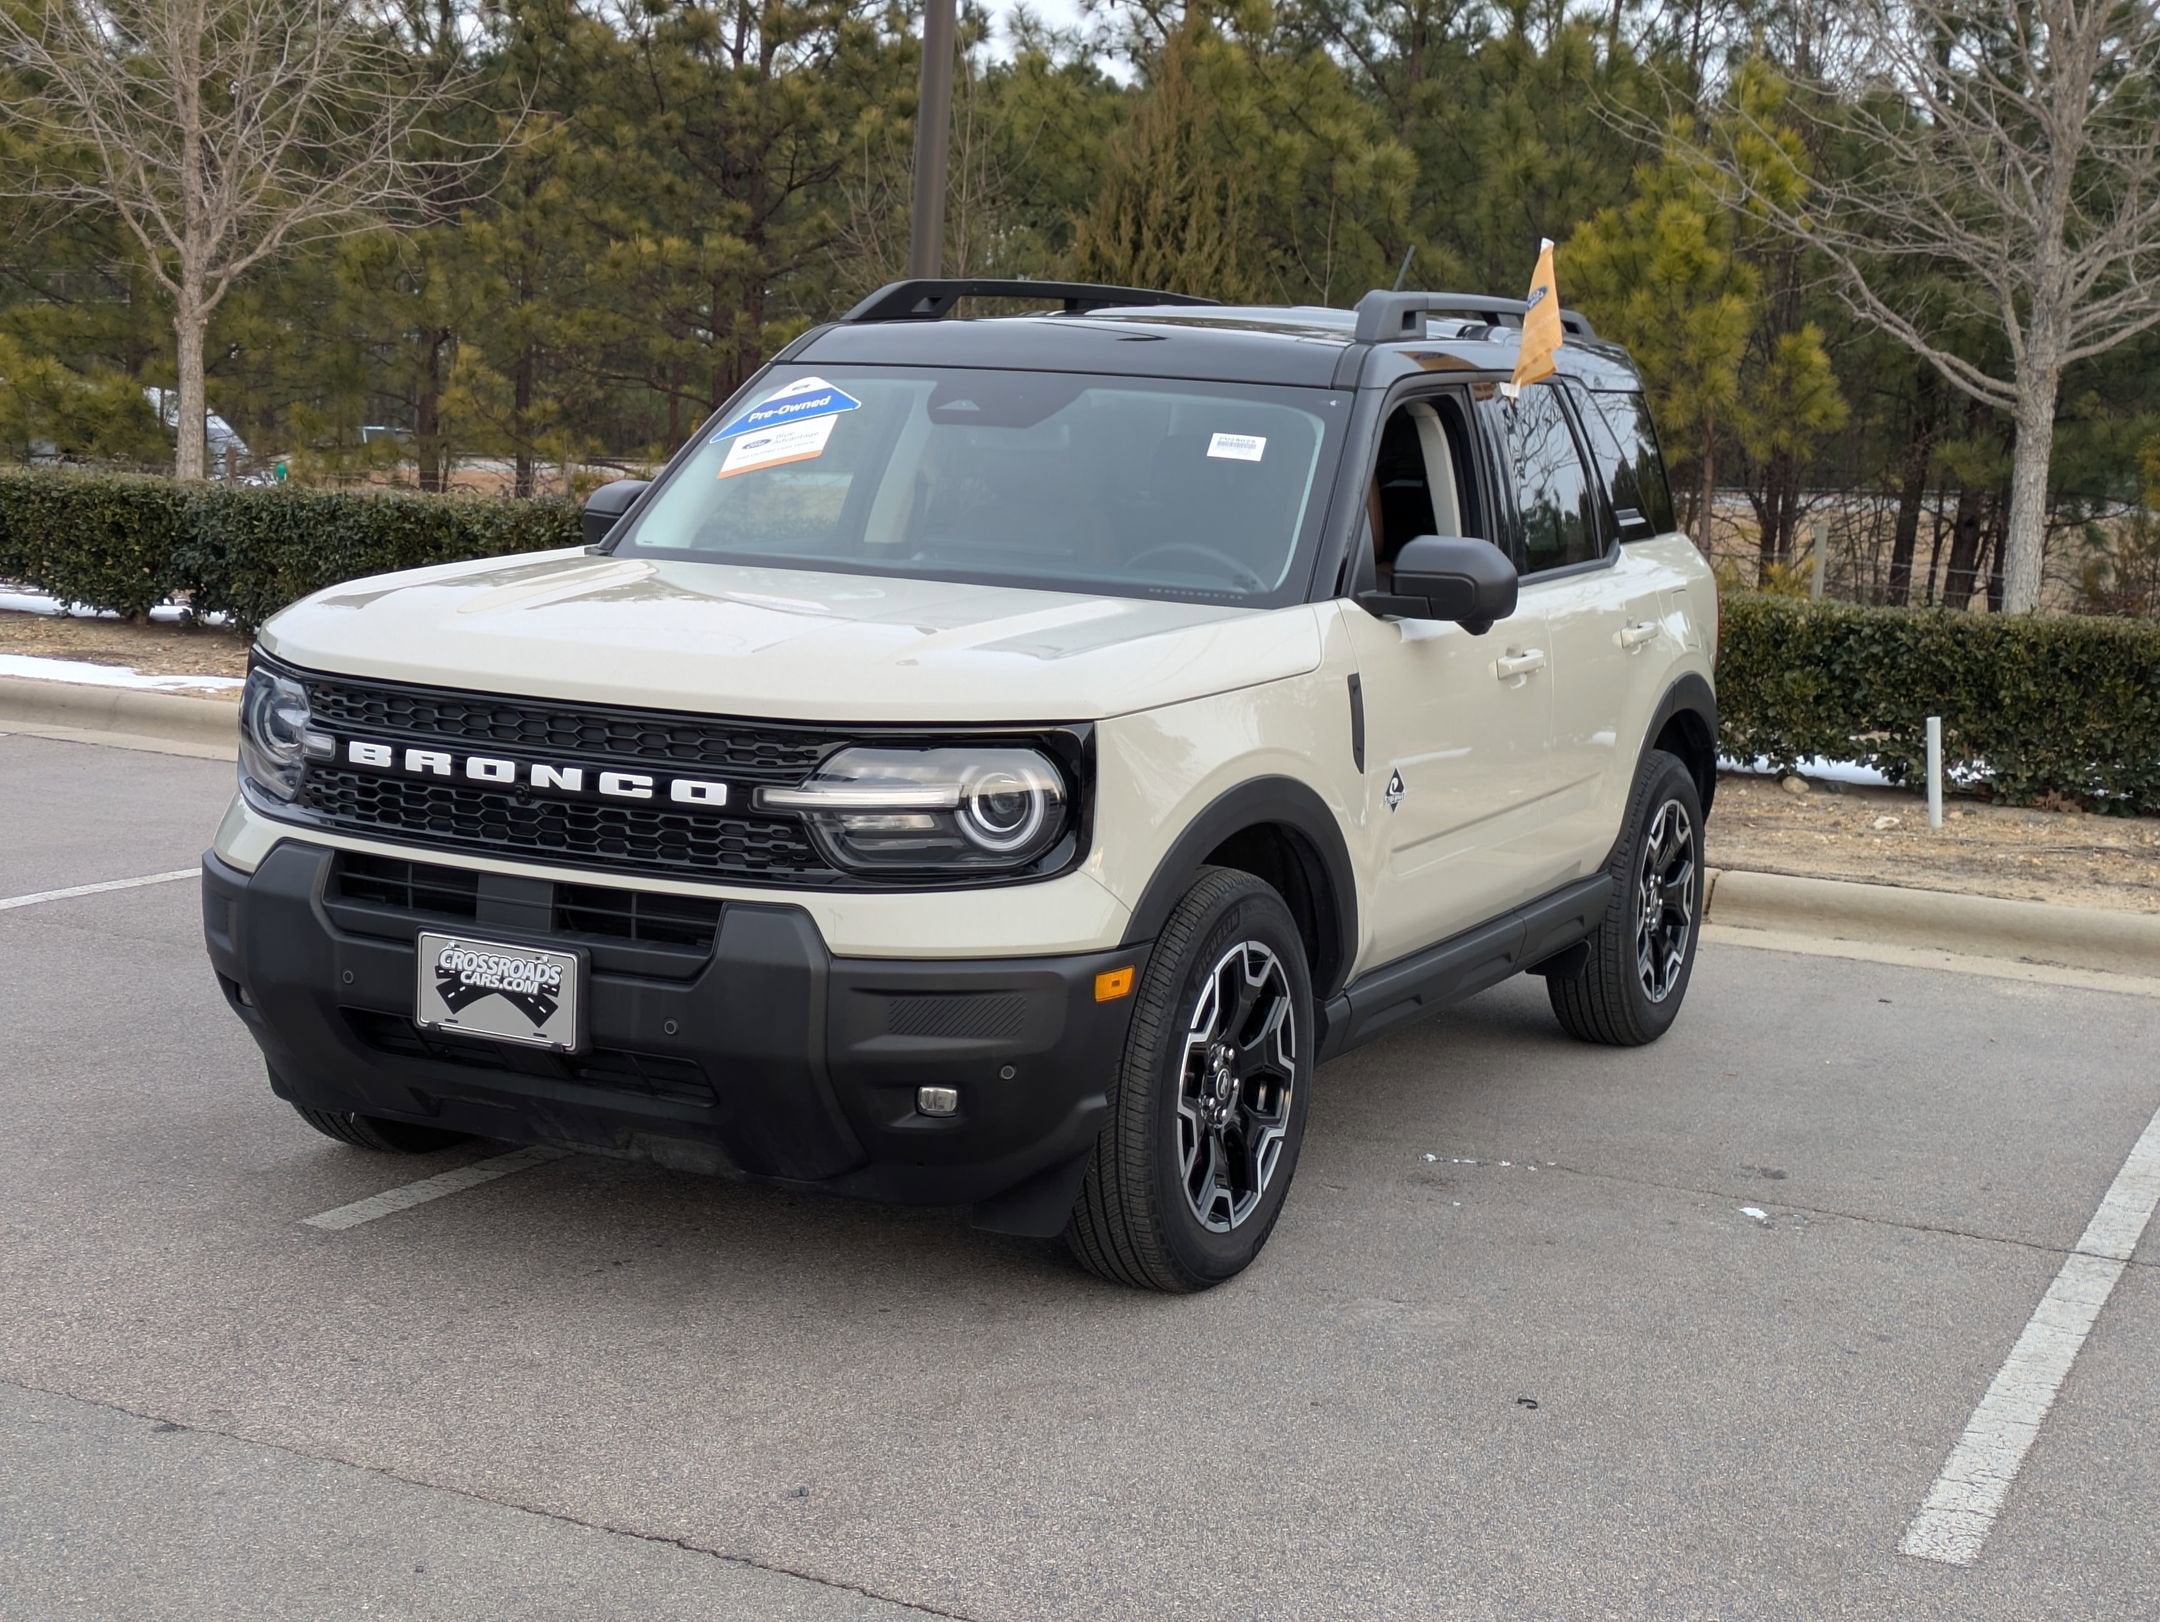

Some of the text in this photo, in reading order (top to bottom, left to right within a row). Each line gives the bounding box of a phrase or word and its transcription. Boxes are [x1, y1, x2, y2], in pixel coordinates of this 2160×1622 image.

[748, 395, 832, 423] Pre-Owned
[348, 741, 727, 806] BRONCO
[438, 948, 563, 985] CROSSROADS
[460, 970, 539, 995] CARS.COM
